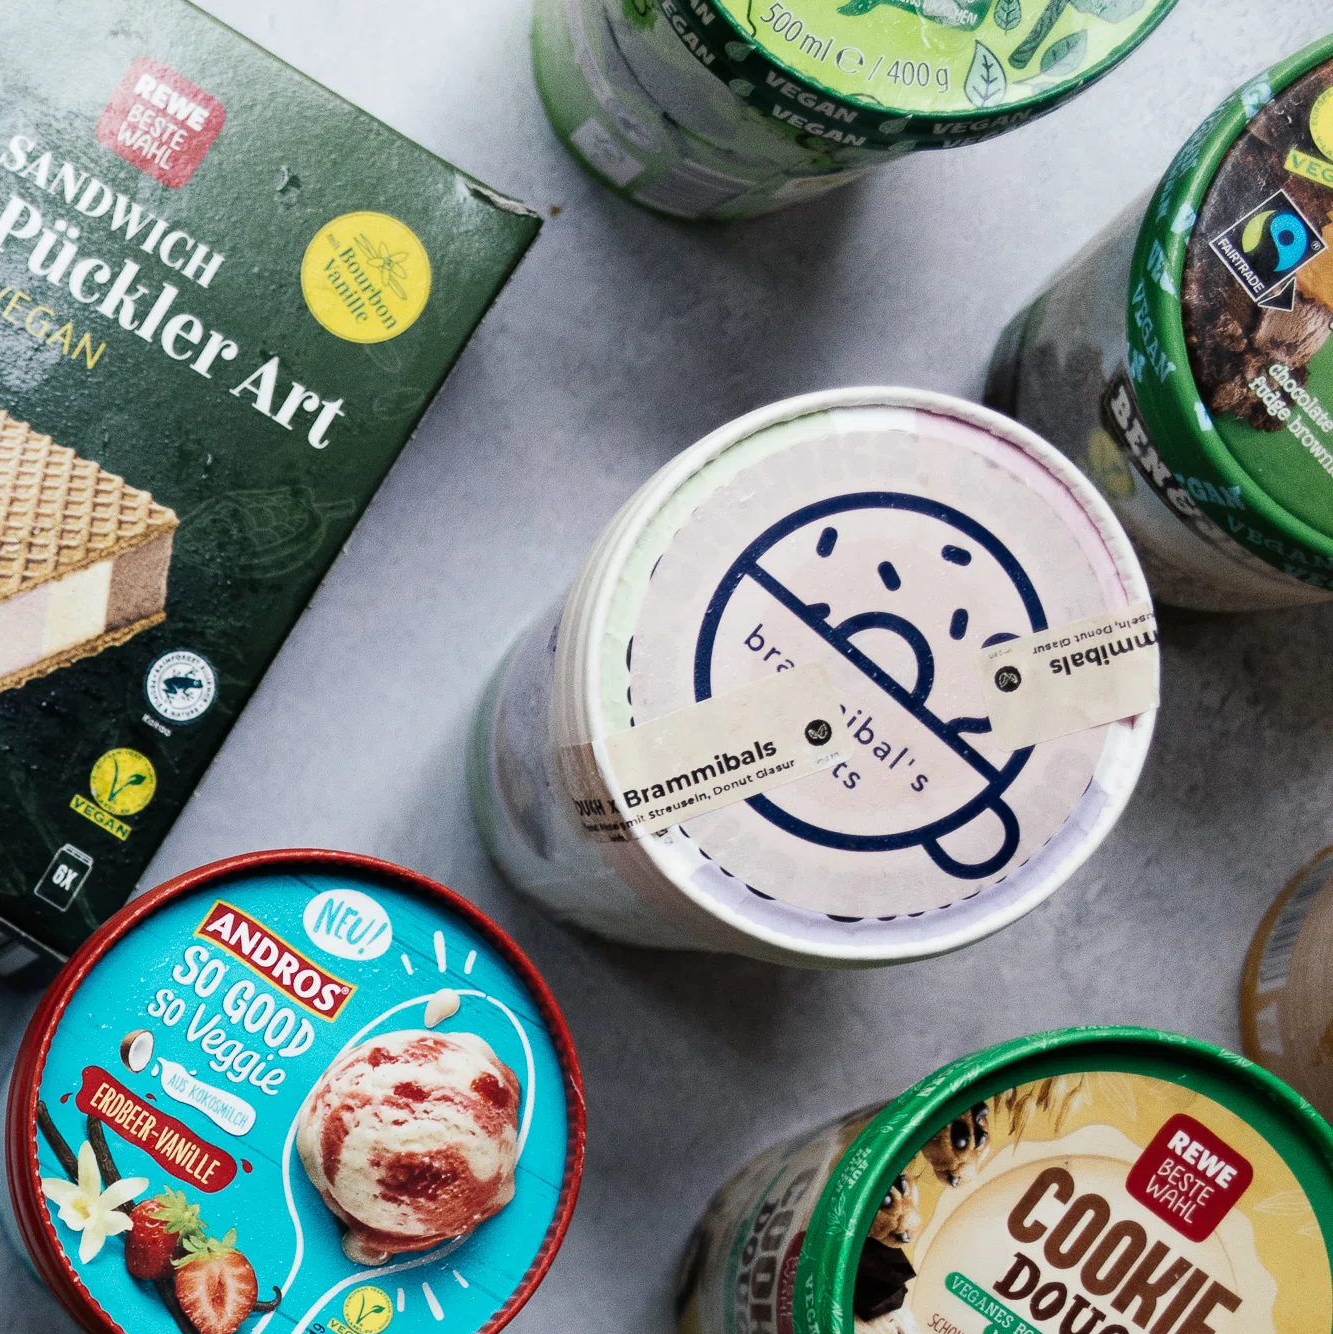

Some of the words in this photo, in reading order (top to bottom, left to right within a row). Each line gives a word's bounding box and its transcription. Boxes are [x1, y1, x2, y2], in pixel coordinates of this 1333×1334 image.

[760, 3, 804, 43] 500
[800, 32, 834, 63] ml
[887, 62, 931, 87] 400
[937, 67, 950, 92] g
[125, 102, 188, 154] BESTE
[132, 72, 209, 131] REWE
[114, 128, 175, 171] WAHL
[324, 258, 368, 324] Vanille
[339, 247, 397, 330] Bourbon
[1217, 237, 1265, 294] FAIRTRADE
[229, 355, 349, 451] Art
[1248, 375, 1290, 422] fudge
[1268, 362, 1332, 434] chocolate
[1033, 639, 1071, 654] Glasur
[1074, 627, 1112, 642] Donut
[623, 740, 778, 808] Brammibals
[712, 775, 754, 796] Donut
[755, 758, 795, 780] Glasur
[206, 912, 342, 1013] ANDROS
[1156, 1157, 1216, 1207] BESTE
[1168, 1129, 1239, 1189] REWE
